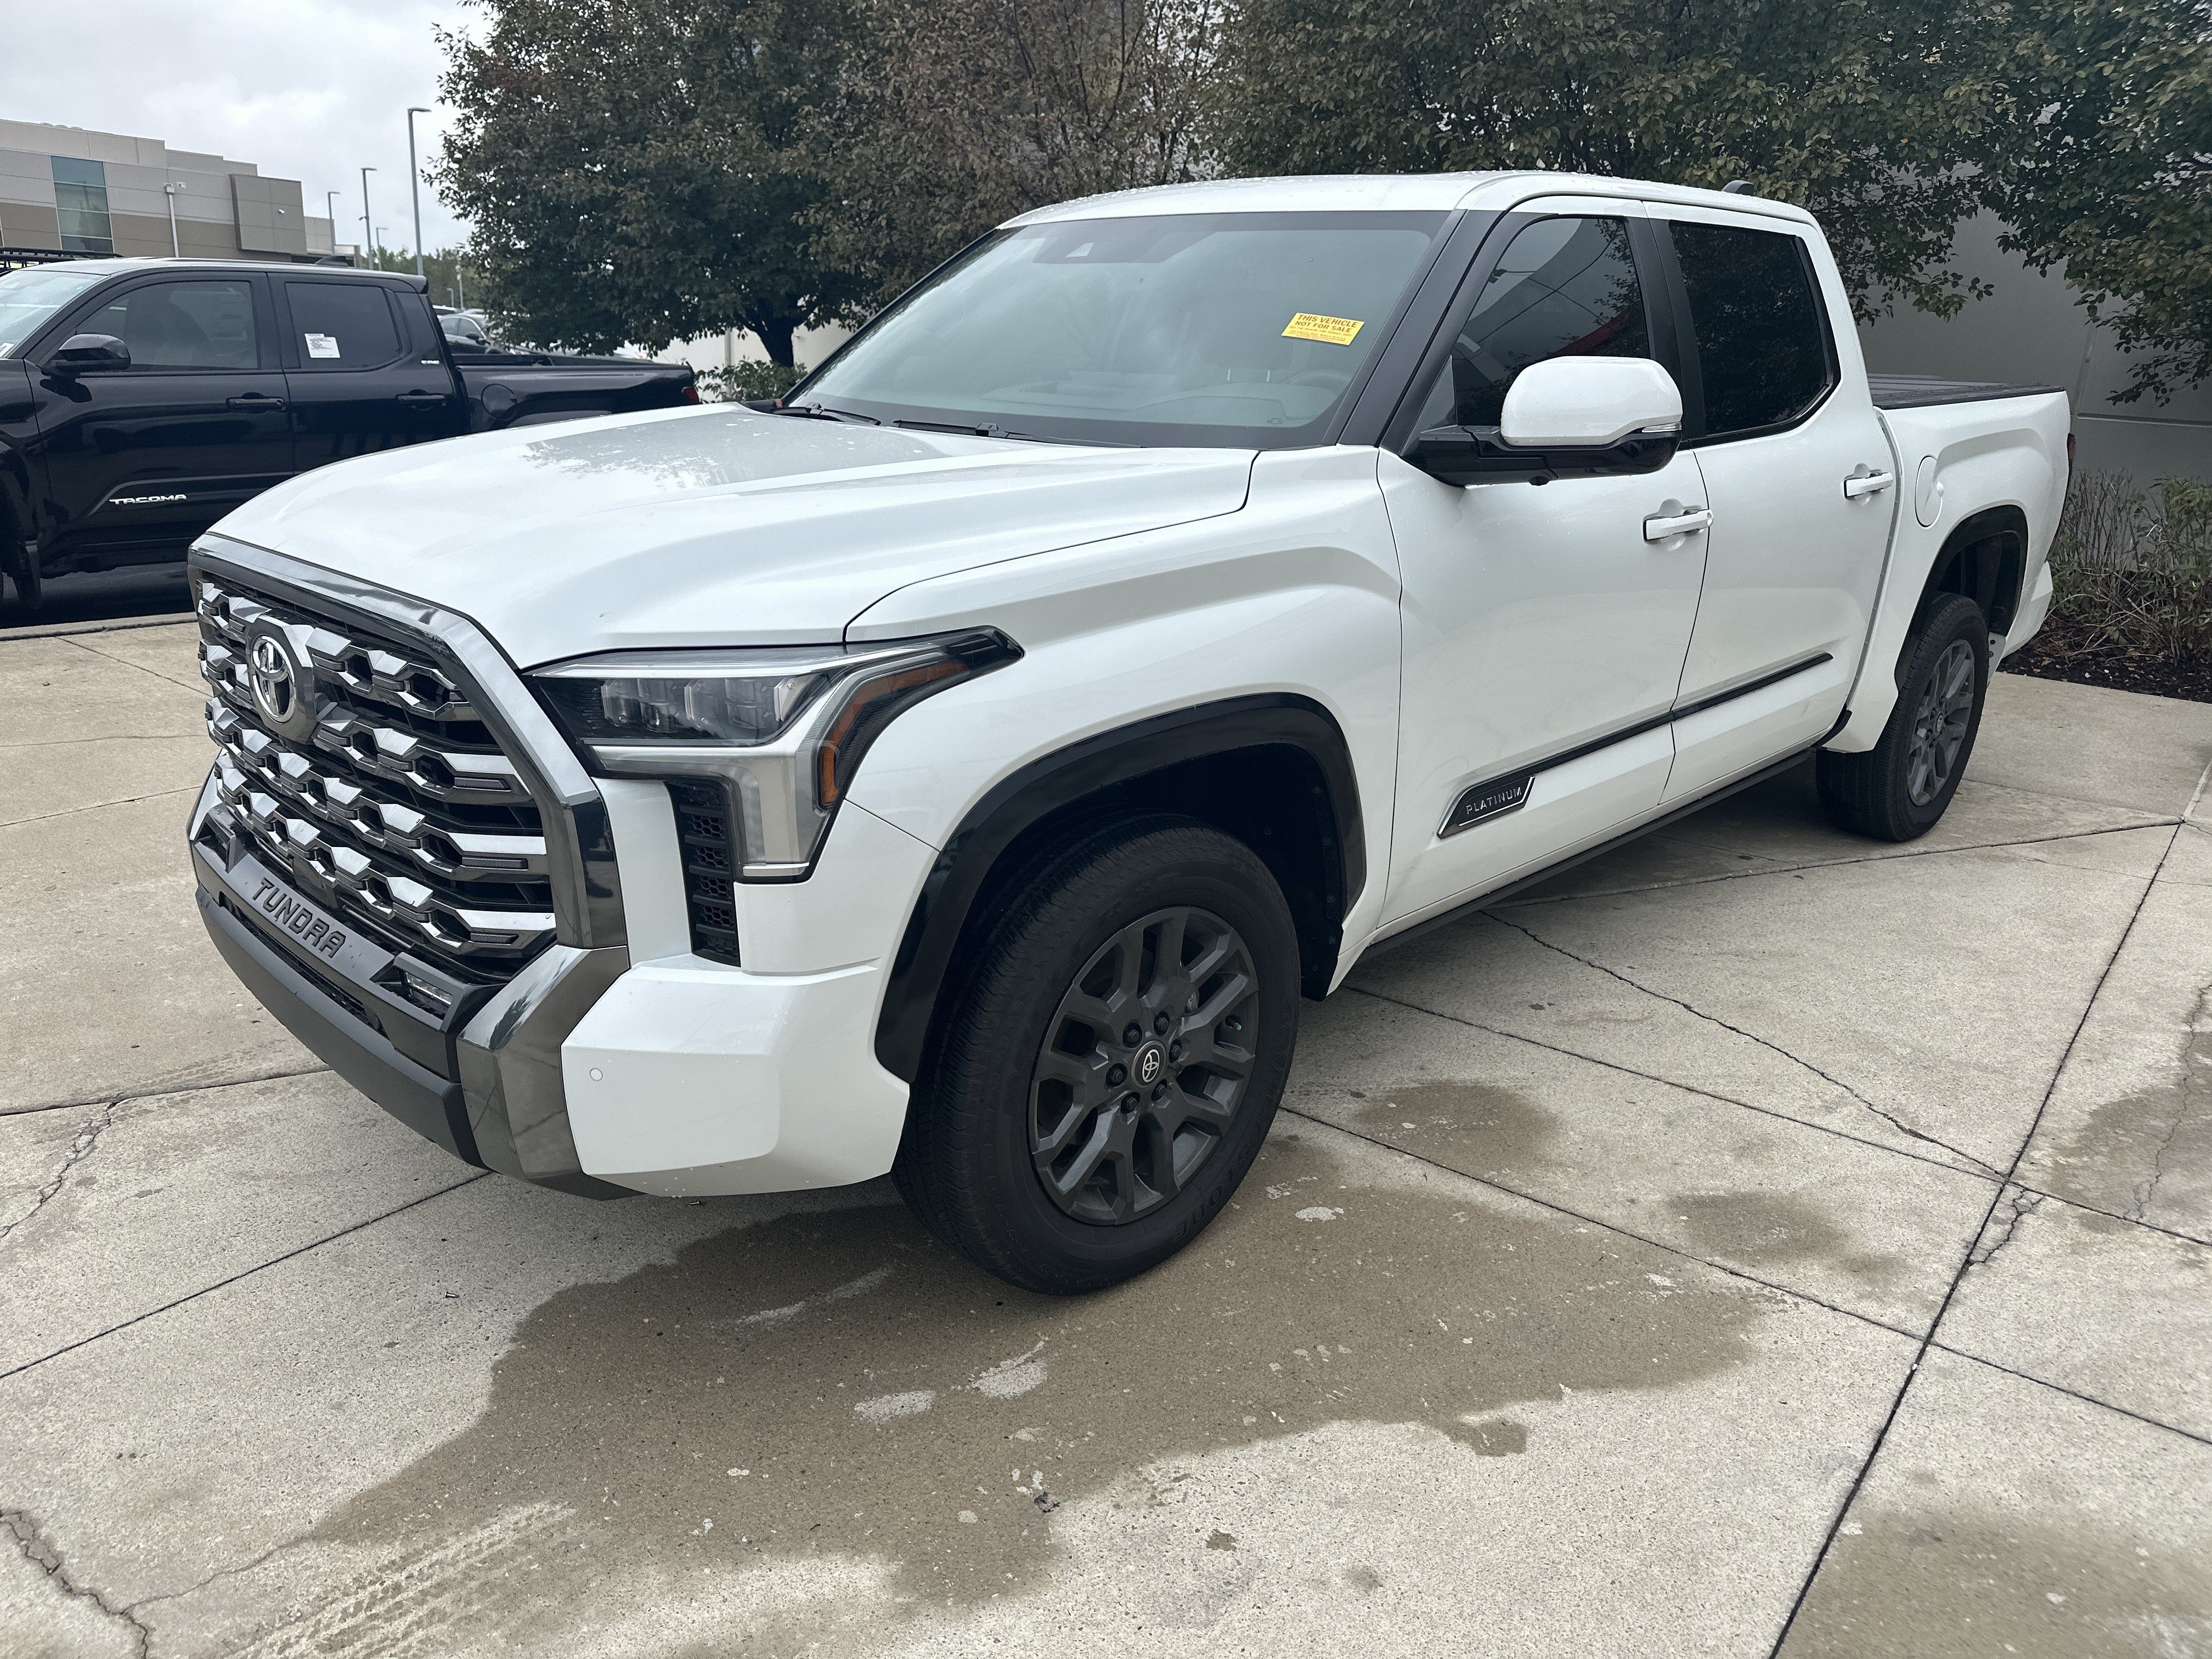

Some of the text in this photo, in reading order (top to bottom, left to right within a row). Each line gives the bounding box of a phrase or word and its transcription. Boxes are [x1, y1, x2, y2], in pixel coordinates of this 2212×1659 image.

[1321, 317, 1359, 328] VEHICLE
[109, 494, 188, 505] TACOMA
[1466, 787, 1522, 815] PLATINUM
[252, 877, 347, 959] TUNDRA
